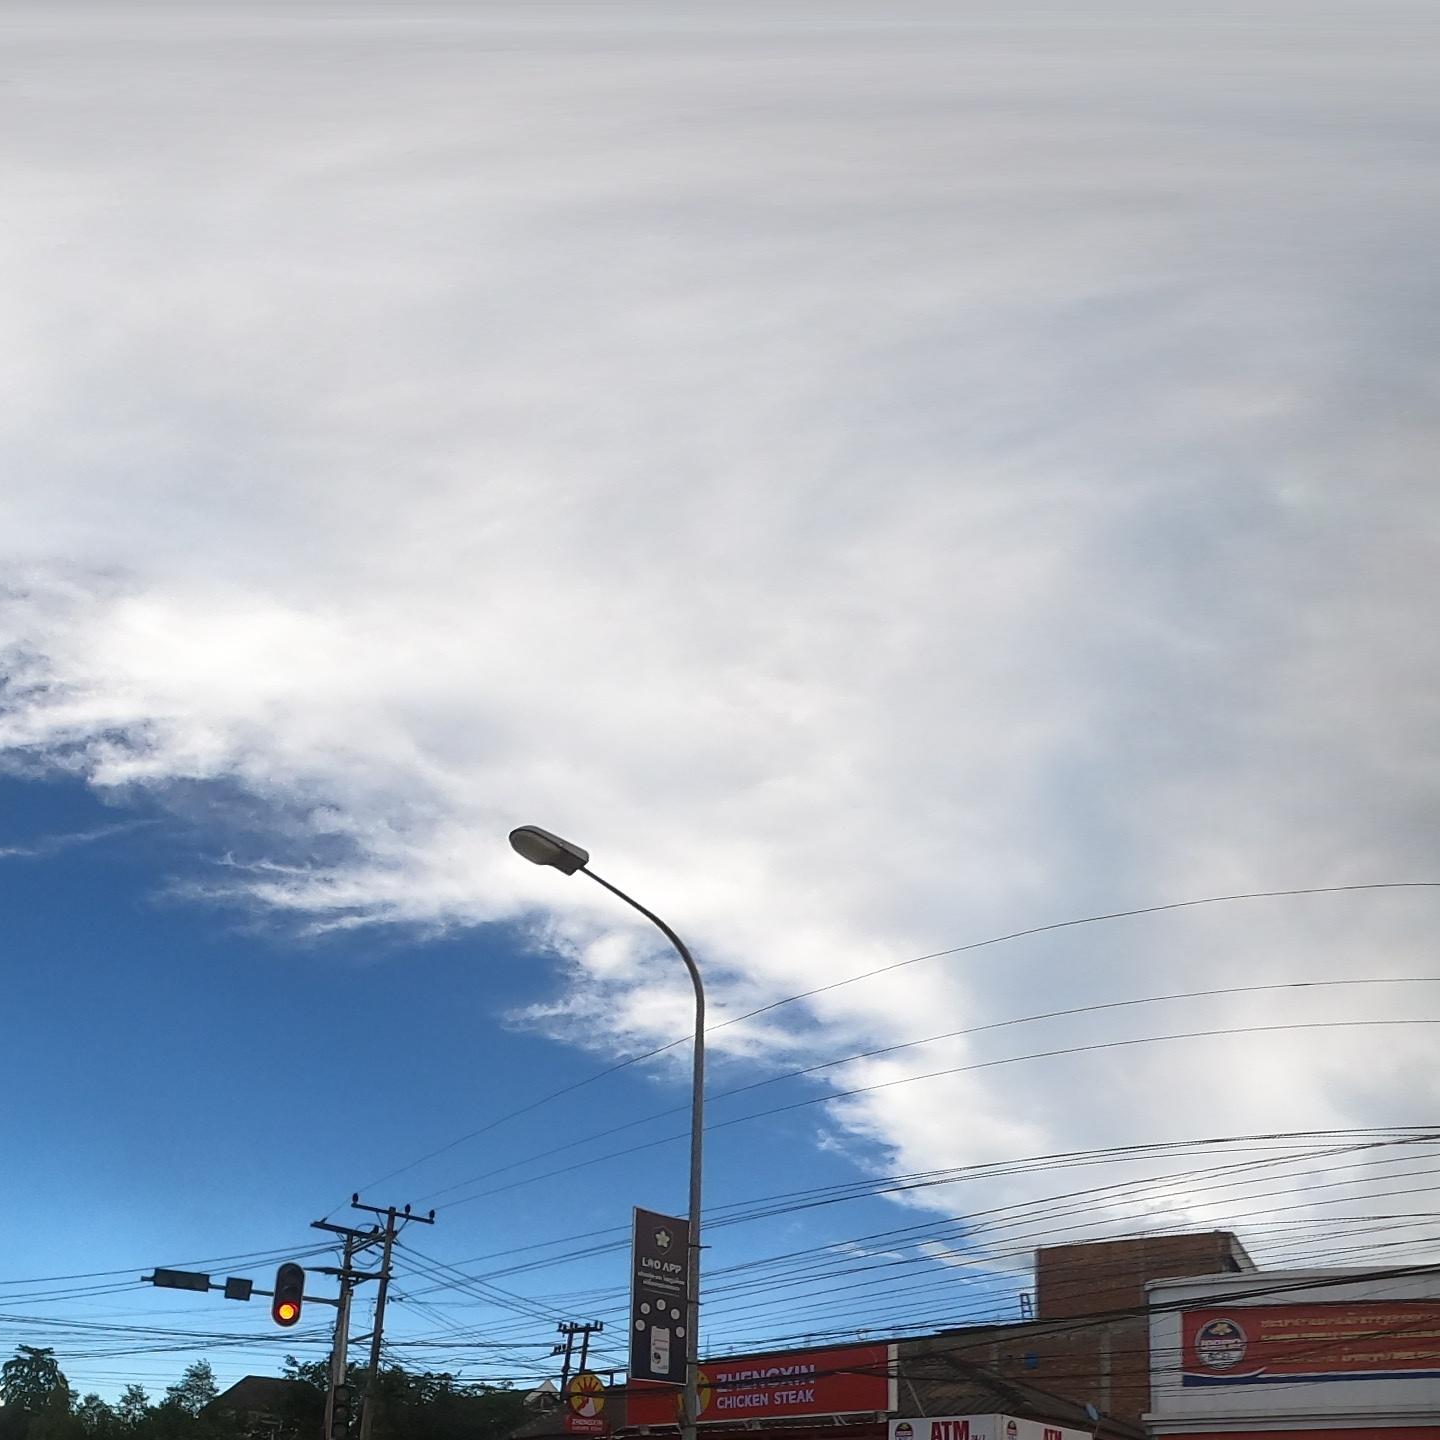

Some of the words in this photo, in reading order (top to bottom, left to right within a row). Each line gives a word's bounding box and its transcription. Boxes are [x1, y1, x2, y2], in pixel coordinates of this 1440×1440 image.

[662, 1262, 682, 1274] APP
[717, 1393, 769, 1409] CHICKEN
[774, 1389, 815, 1405] STEAK
